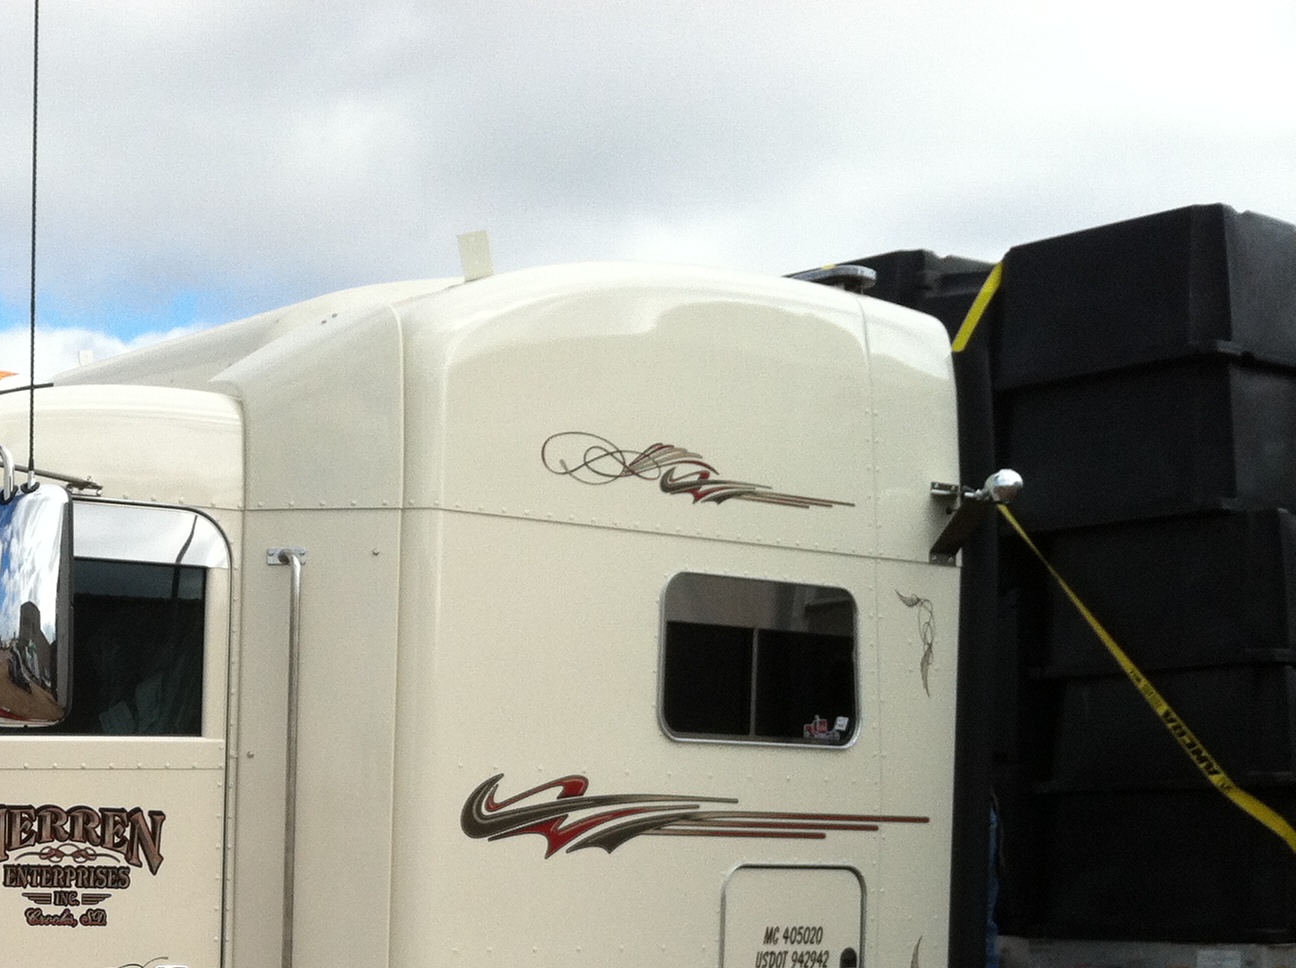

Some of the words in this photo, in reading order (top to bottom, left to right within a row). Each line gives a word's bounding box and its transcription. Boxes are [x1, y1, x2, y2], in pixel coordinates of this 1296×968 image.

[2, 864, 131, 889] ENTERPRISES
[79, 908, 108, 927] SD
[763, 926, 780, 945] MC
[782, 926, 824, 945] 405020
